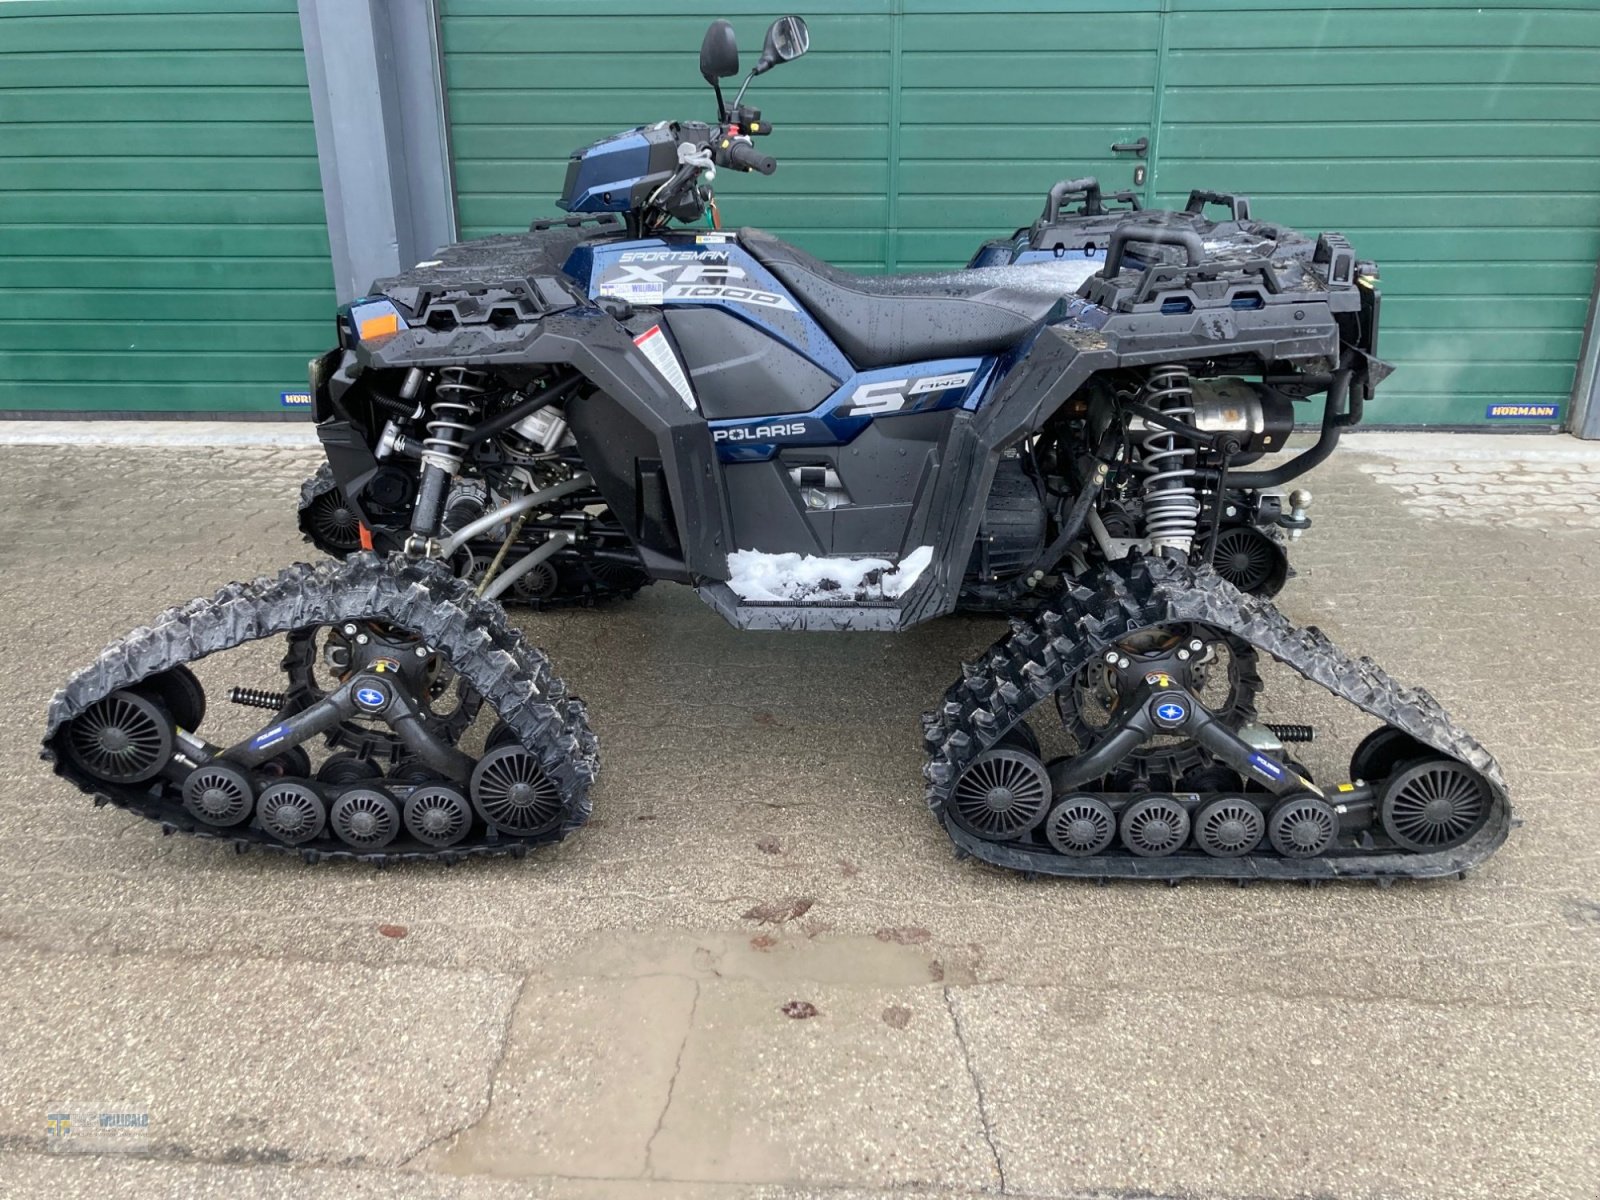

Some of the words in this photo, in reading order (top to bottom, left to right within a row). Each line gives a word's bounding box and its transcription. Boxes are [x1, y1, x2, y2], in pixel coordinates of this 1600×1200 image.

[618, 250, 730, 263] SPORTSMAN
[604, 264, 747, 283] XP
[677, 286, 783, 304] 1000
[850, 379, 908, 416] S
[713, 422, 806, 443] POLARIS
